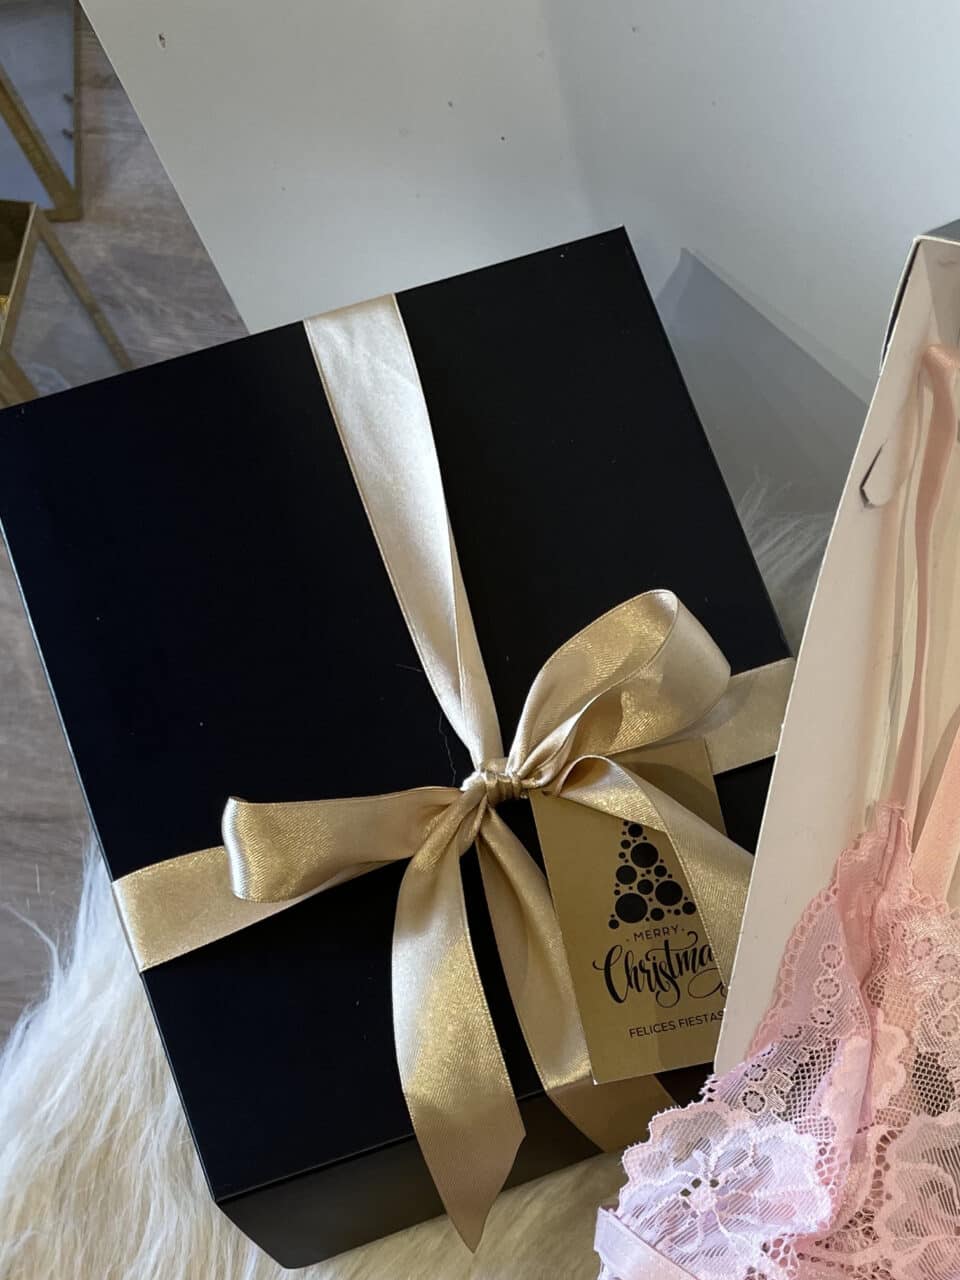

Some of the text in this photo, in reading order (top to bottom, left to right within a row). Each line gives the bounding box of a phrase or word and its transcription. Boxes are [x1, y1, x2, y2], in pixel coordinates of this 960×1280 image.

[633, 924, 679, 942] MERRY
[592, 931, 727, 1008] Christma
[629, 1010, 724, 1038] FELICES FIESTAS
